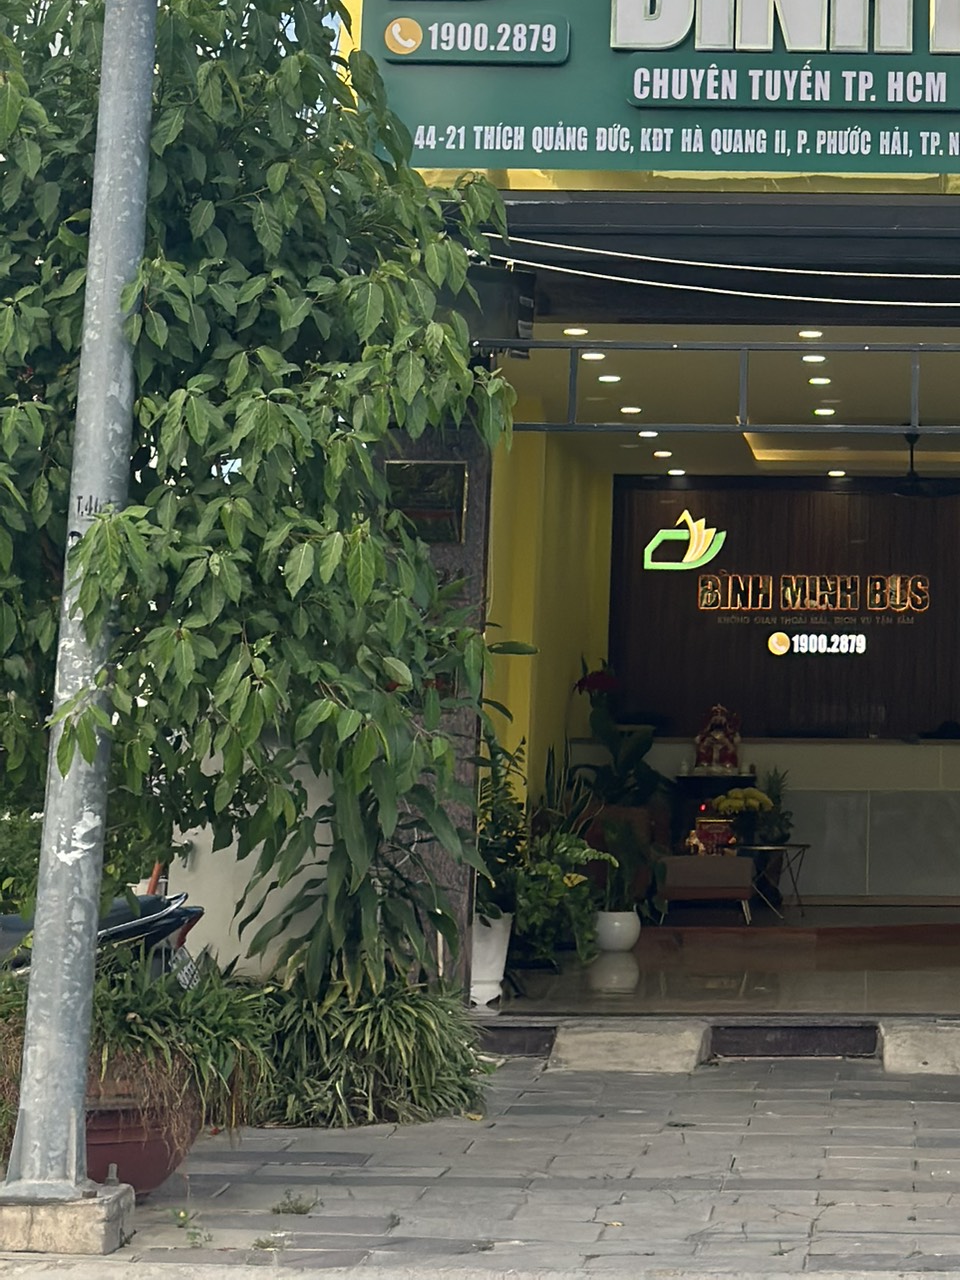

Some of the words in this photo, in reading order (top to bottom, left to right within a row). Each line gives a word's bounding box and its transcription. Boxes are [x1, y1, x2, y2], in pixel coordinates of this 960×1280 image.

[429, 22, 557, 52] 1900.2879
[634, 63, 738, 100] CHUYÊN
[749, 60, 830, 102] TUYẾN
[842, 71, 876, 102] TP.
[888, 72, 947, 102] HCM
[414, 125, 466, 150] 44-21
[474, 122, 524, 151] THÍCH
[532, 121, 588, 152] QUẢNG
[596, 122, 634, 154] ĐỨC,
[640, 129, 671, 152] KĐT
[681, 124, 704, 152] HÀ
[711, 129, 766, 154] QUANG
[774, 130, 791, 156] II,
[797, 130, 811, 154] P.
[816, 125, 871, 155] PHƯỚC
[879, 125, 913, 157] HẢI,
[920, 131, 944, 156] TP.
[698, 569, 774, 610] BÌNH
[780, 574, 860, 611] MINH
[867, 574, 931, 612] BUS
[792, 634, 866, 654] 1900.2879
